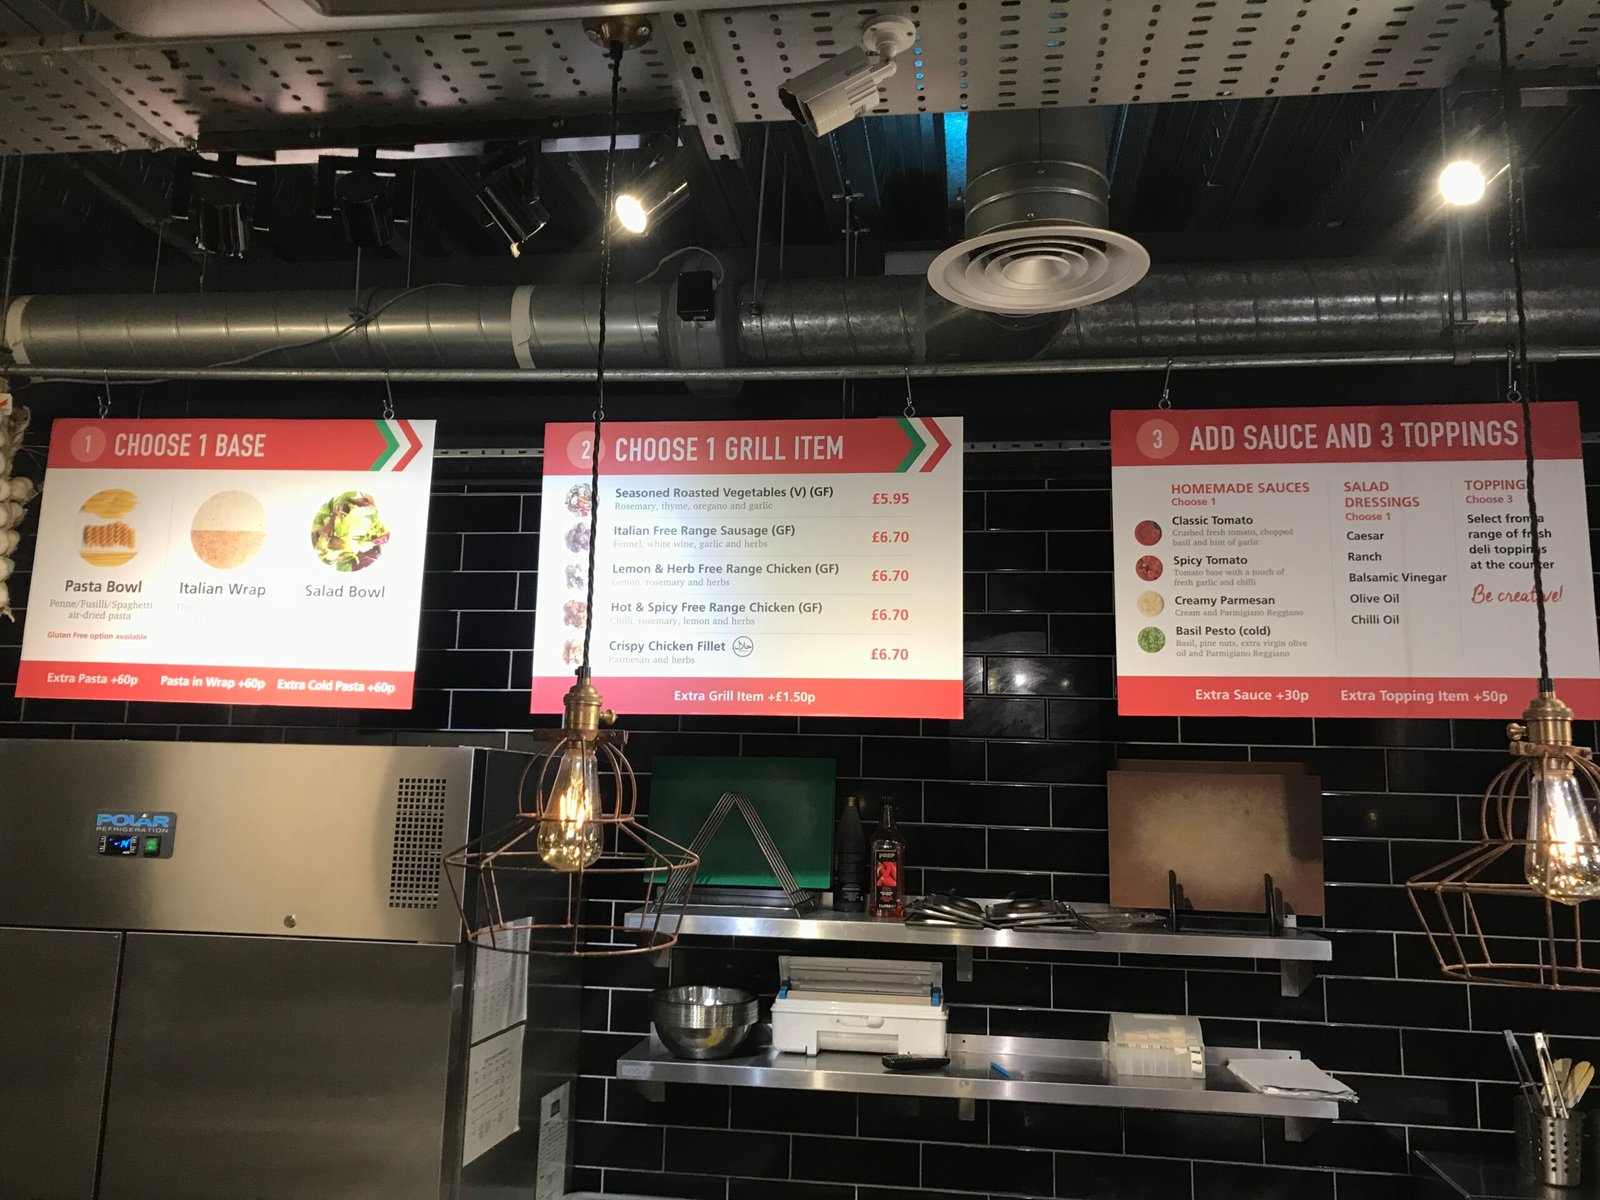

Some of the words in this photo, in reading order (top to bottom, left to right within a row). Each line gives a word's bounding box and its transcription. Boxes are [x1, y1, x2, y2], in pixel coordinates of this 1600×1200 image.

[1153, 429, 1162, 449] 3
[1189, 425, 1235, 451] ADD
[1243, 423, 1318, 450] SAUCE
[1325, 422, 1372, 449] AND
[1380, 422, 1394, 448] 3
[1400, 419, 1518, 447] TOPPINGS
[85, 435, 91, 453] 1
[114, 433, 192, 456] CHOOSE
[199, 433, 207, 457] 1
[214, 433, 266, 457] BASE
[581, 440, 591, 459] 2
[615, 437, 698, 462] CHOOSE
[706, 436, 714, 461] 1
[725, 436, 786, 461] GRILL
[794, 435, 843, 460] ITEM
[615, 487, 670, 498] Seasoned
[673, 487, 719, 498] Roasted
[722, 486, 786, 500] Vegetables
[789, 486, 806, 499] (V)
[809, 486, 834, 498] (GF)
[1171, 482, 1253, 494] HOMEMADE
[1257, 481, 1310, 493] SAUCES
[1343, 481, 1389, 492] SALAD
[872, 492, 909, 504] £5.95
[1171, 497, 1208, 506] Choose
[1210, 497, 1216, 506] 1
[1344, 496, 1420, 508] DRESSINGS
[1465, 494, 1504, 504] Choose
[1506, 494, 1513, 503] 3
[614, 502, 658, 512] Rosemary,
[661, 501, 690, 512] thyme,
[692, 503, 728, 512] oregano
[729, 501, 746, 510] and
[748, 500, 773, 511] garlic
[1172, 515, 1208, 525] Classic
[1210, 515, 1254, 525] Tomato
[1345, 512, 1382, 521] Choose
[1385, 511, 1390, 520] 1
[1467, 514, 1502, 524] Select
[1538, 514, 1545, 523] a
[614, 525, 650, 536] Italian
[653, 525, 678, 536] Free
[680, 525, 717, 538] Range
[720, 525, 768, 538] Sausage
[771, 524, 795, 537] (GF)
[871, 530, 909, 543] £6.70
[1171, 528, 1204, 536] Crushed
[1206, 528, 1226, 536] fresh
[1227, 529, 1258, 537] tomato,
[1259, 527, 1294, 537] chopped
[1346, 531, 1384, 541] Caesar
[1468, 531, 1502, 541] range
[1506, 528, 1519, 539] of
[1522, 528, 1552, 539] frsh
[1347, 551, 1382, 561] Ranch
[1469, 544, 1491, 555] deli
[1495, 544, 1547, 556] toppins
[1173, 555, 1202, 567] Spicy
[1205, 555, 1248, 565] Tomato
[1470, 560, 1483, 570] at
[1485, 559, 1505, 569] the
[612, 563, 651, 574] Lemon
[654, 563, 663, 573] &
[666, 562, 695, 574] Herb
[698, 563, 723, 574] Free
[726, 563, 762, 576] Range
[766, 562, 812, 574] Chicken
[814, 562, 839, 575] (GF)
[871, 569, 909, 582] £6.70
[1172, 568, 1204, 576] Tomato
[1205, 567, 1223, 576] base
[1224, 567, 1243, 576] with
[1251, 567, 1274, 576] touch
[1276, 567, 1285, 575] of
[1348, 572, 1398, 582] Balsamic
[1401, 572, 1447, 584] Vinegar
[64, 579, 102, 592] Pasta
[106, 580, 142, 593] Bowl
[179, 581, 223, 594] Italian
[228, 583, 266, 598] Wrap
[305, 584, 344, 597] Salad
[348, 585, 385, 598] Bowl
[1349, 593, 1380, 603] Olive
[1383, 593, 1399, 603] Oil
[1471, 583, 1493, 604] Be
[1497, 583, 1564, 602] creatve!
[49, 598, 153, 611] Penne/Fusilli/Spaghetti
[1174, 595, 1217, 607] Creamy
[1220, 595, 1275, 605] Parmesan
[610, 602, 632, 612] Hot
[635, 601, 644, 612] &
[648, 601, 678, 615] Spicy
[681, 602, 706, 612] Free
[709, 602, 746, 615] Range
[749, 601, 795, 613] Chicken
[798, 601, 822, 614] (GF)
[871, 608, 909, 621] £6.70
[1174, 608, 1201, 616] Cream
[1202, 608, 1218, 616] and
[1219, 608, 1265, 618] Parmigiano
[1266, 608, 1304, 618] Reggiano
[67, 610, 106, 620] air-dried
[107, 612, 131, 622] pasta
[1350, 614, 1380, 625] Chilli
[1382, 614, 1399, 625] Oil
[46, 631, 72, 639] Gluten
[72, 631, 88, 639] Free
[89, 632, 114, 641] option
[1176, 625, 1202, 635] Basil
[1204, 626, 1236, 635] Pesto
[1238, 625, 1271, 637] (cold)
[608, 640, 645, 653] Crispy
[648, 640, 694, 651] Chicken
[697, 640, 726, 651] Fillet
[1175, 639, 1197, 648] Basil,
[1199, 639, 1216, 649] pine
[1218, 640, 1239, 648] nuts,
[1262, 639, 1286, 649] virgin
[1288, 639, 1308, 647] olive
[870, 647, 908, 660] £6.70
[46, 672, 76, 683] Extra
[78, 673, 108, 684] Pasta
[110, 674, 138, 687] +60p
[160, 675, 190, 686] Pasta
[192, 675, 203, 687] in
[205, 676, 236, 690] Wrap
[237, 677, 266, 691] +60p
[276, 678, 306, 690] Extra
[307, 679, 334, 691] Cold
[334, 680, 365, 692] Pasta
[367, 681, 396, 695] +60p
[674, 690, 705, 701] Extra
[708, 690, 733, 701] Grill
[737, 690, 764, 702] Item
[767, 691, 816, 705] +£1.50p
[1195, 689, 1230, 700] Extra
[1233, 689, 1272, 700] Sauce
[1276, 689, 1309, 703] +30p
[1340, 689, 1376, 701] Extra
[1378, 689, 1434, 704] Topping
[1438, 690, 1469, 702] Item
[1473, 690, 1508, 705] +50p
[96, 813, 169, 827] POLAR
